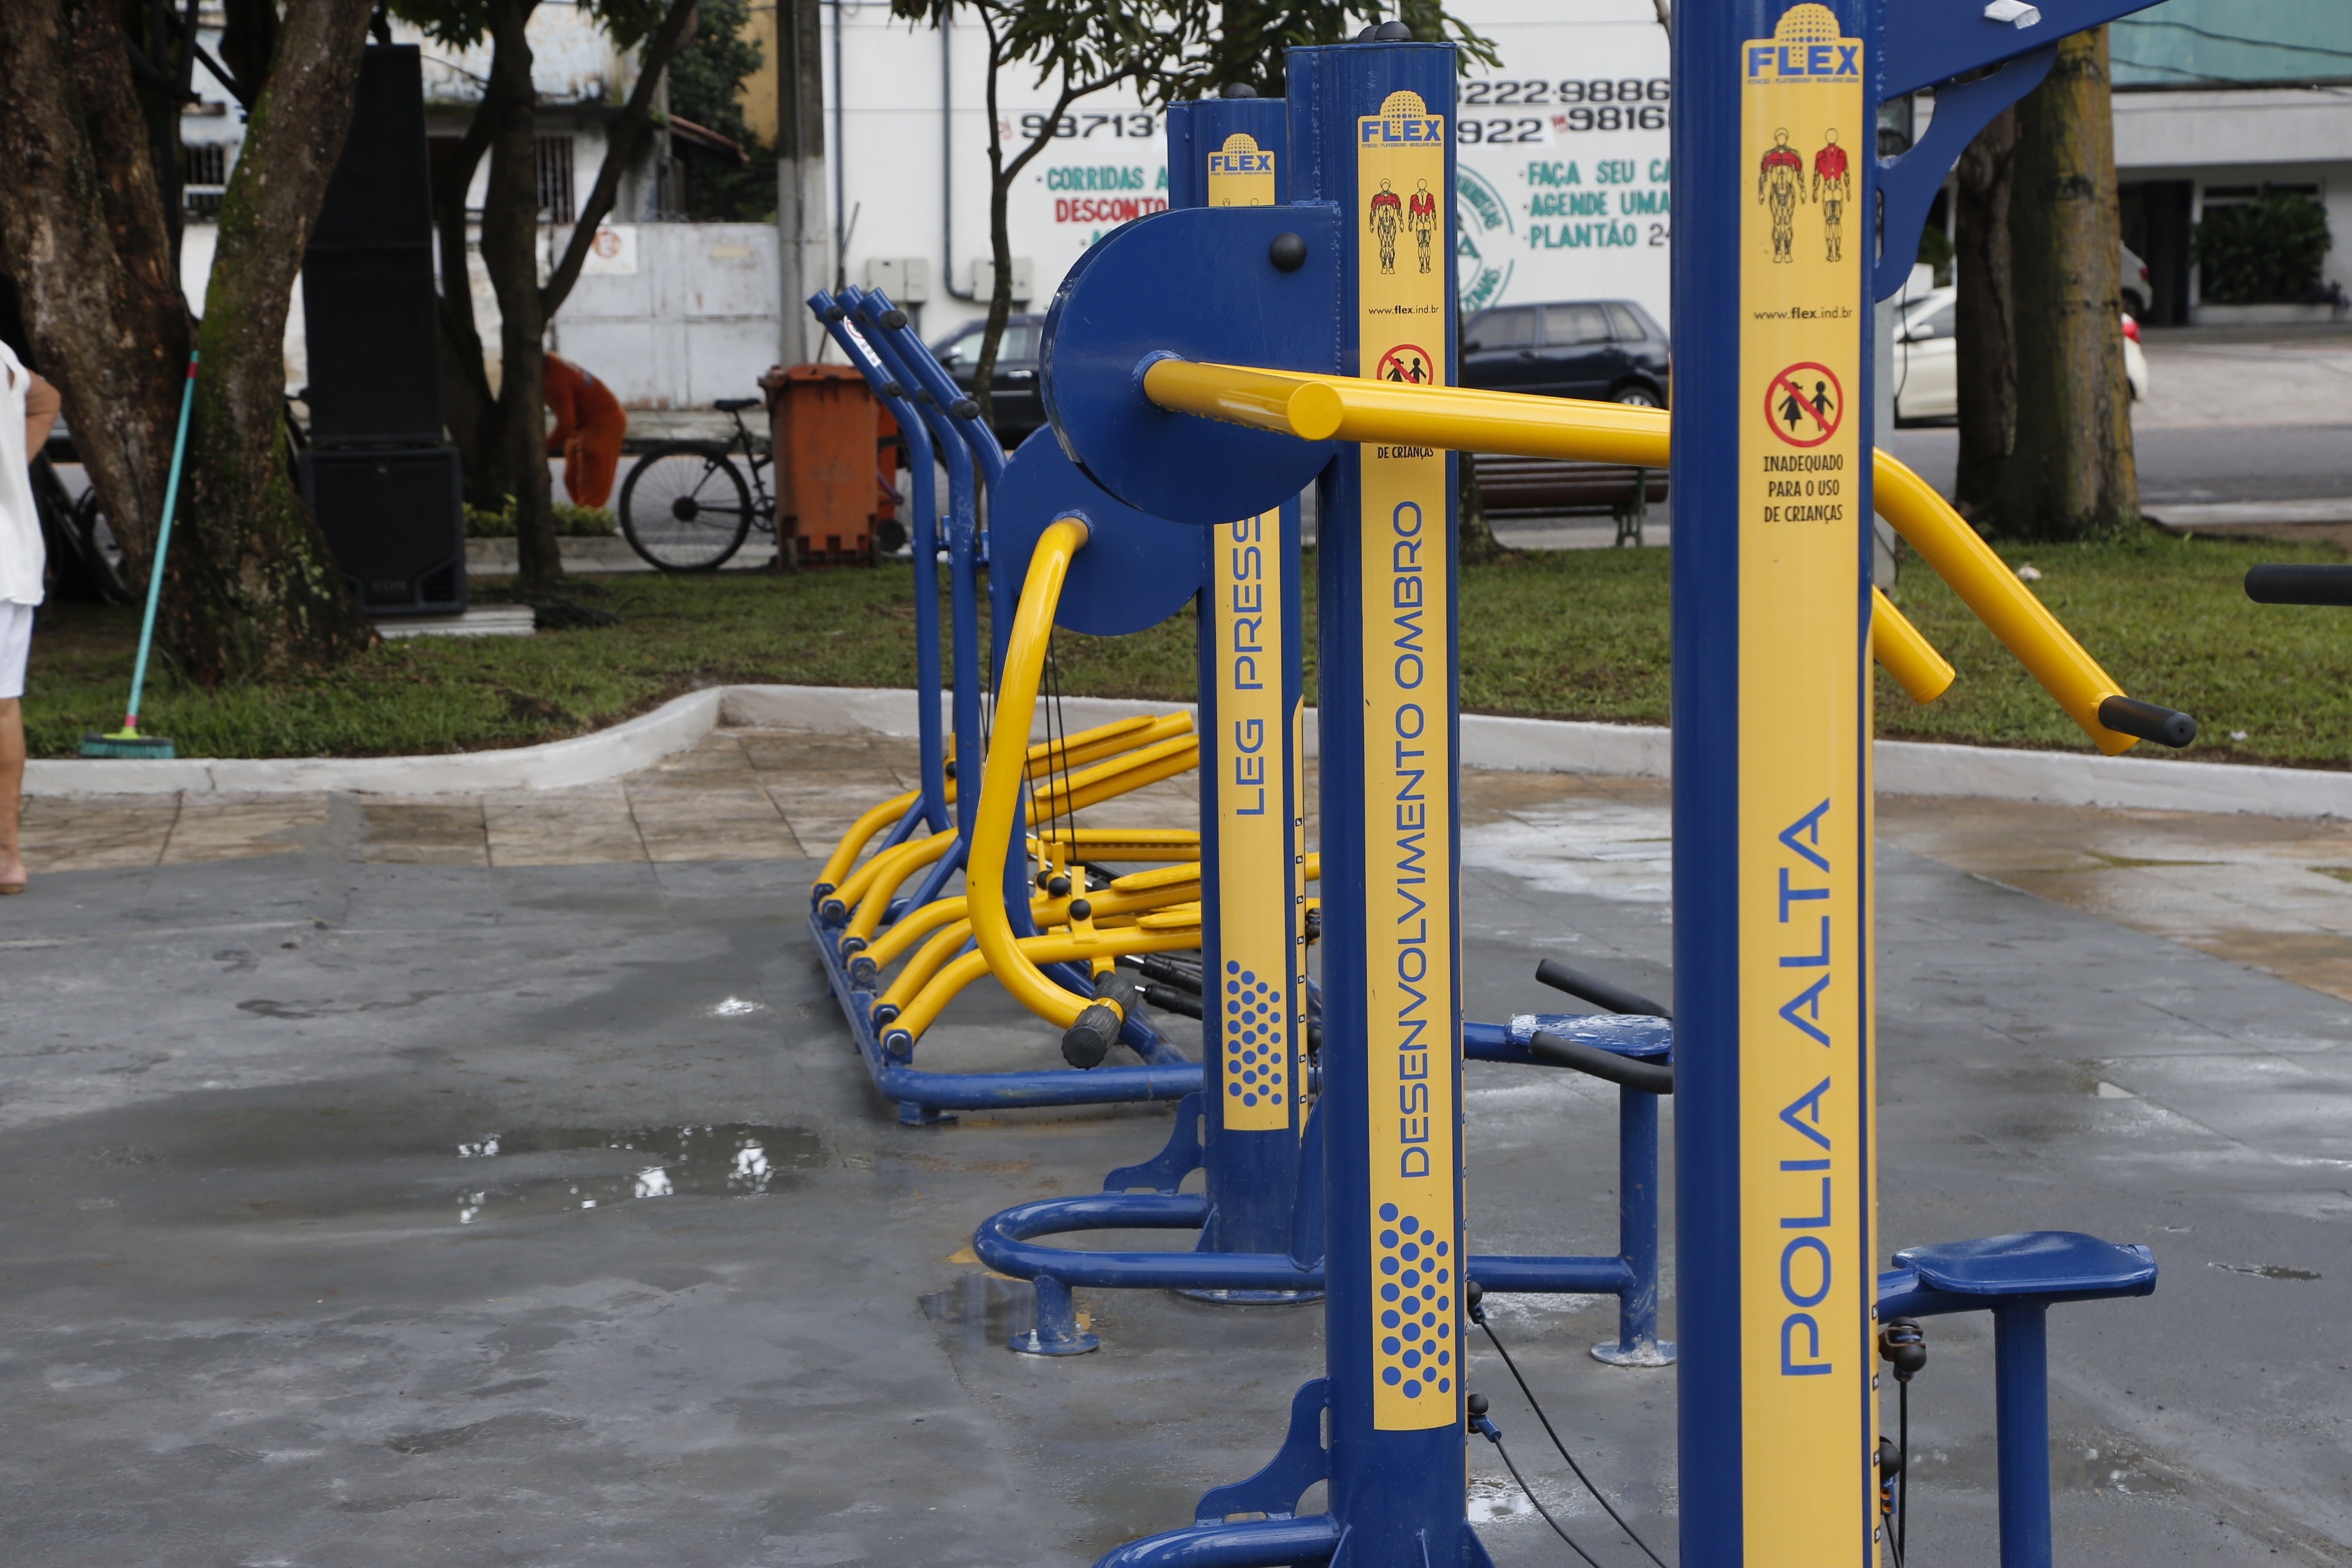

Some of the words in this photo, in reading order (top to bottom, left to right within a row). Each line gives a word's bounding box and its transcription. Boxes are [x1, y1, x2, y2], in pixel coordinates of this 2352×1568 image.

[1749, 45, 1858, 77] FLEX
[1569, 107, 1670, 130] 9816
[1362, 120, 1441, 142] FLEX
[1210, 155, 1272, 172] FLEX
[1528, 162, 1581, 187] FAÇA
[1597, 160, 1634, 183] SEU
[1047, 167, 1144, 190] CORRIDAS
[1531, 191, 1607, 216] AGENDE
[1621, 190, 1670, 214] UMA
[1531, 219, 1637, 248] PLANTÃO
[1368, 304, 1439, 314] www.flex.ind.br
[1755, 307, 1852, 319] www.flex.ind.br
[1378, 447, 1389, 459] DE
[1392, 446, 1433, 460] CRIANÇAS
[1764, 454, 1843, 473] INADEQUADO
[1769, 480, 1801, 497] PARA
[1806, 480, 1814, 496] O
[1818, 479, 1840, 496] USO
[1765, 506, 1781, 522] DE
[1784, 504, 1843, 524] CRIANÇAS
[1232, 515, 1263, 690] PRESS
[1393, 501, 1423, 690] OMBRO
[1235, 718, 1264, 815] LEG
[1779, 797, 1831, 1048] ALTA
[1395, 703, 1430, 1178] DESENVOLVIMENTO
[1780, 1076, 1832, 1376] POLIA
